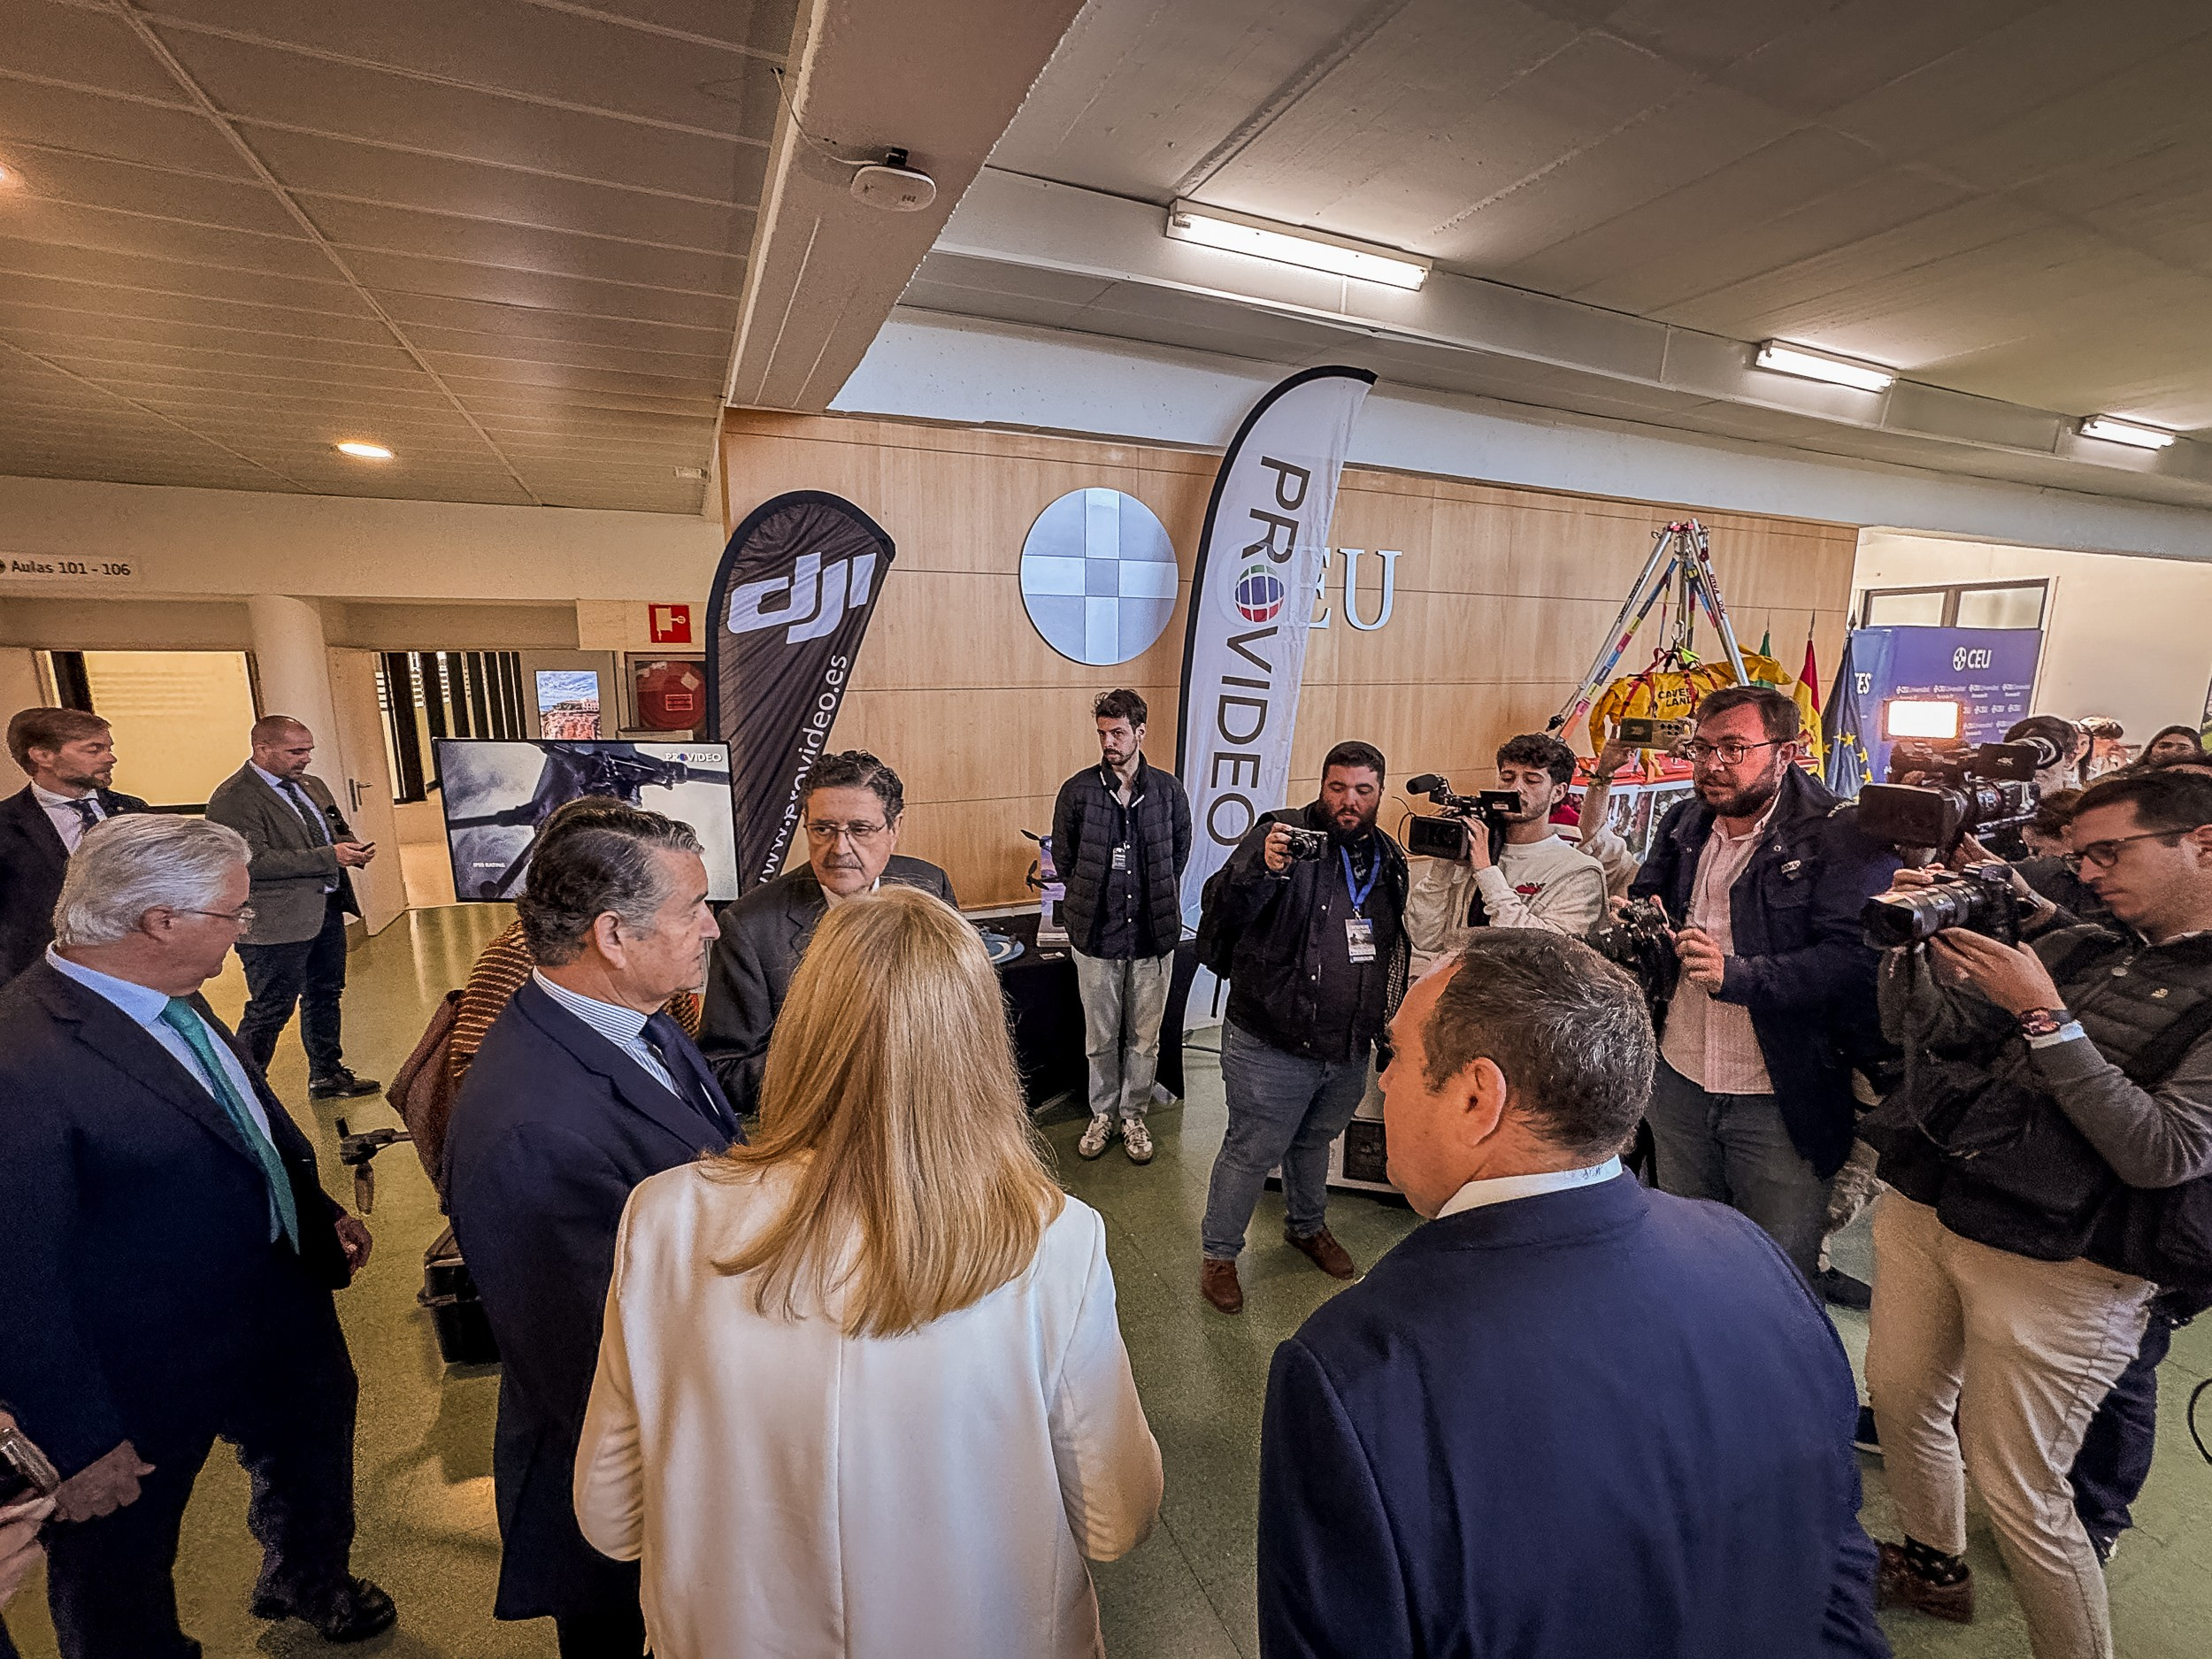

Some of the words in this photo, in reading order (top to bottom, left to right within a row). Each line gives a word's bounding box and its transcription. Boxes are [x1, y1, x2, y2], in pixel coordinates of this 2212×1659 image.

[12, 560, 55, 573] Aulas
[58, 561, 88, 574] 101
[102, 563, 131, 576] 106
[1967, 649, 1993, 669] CEU
[665, 752, 723, 763] PROVIDEO
